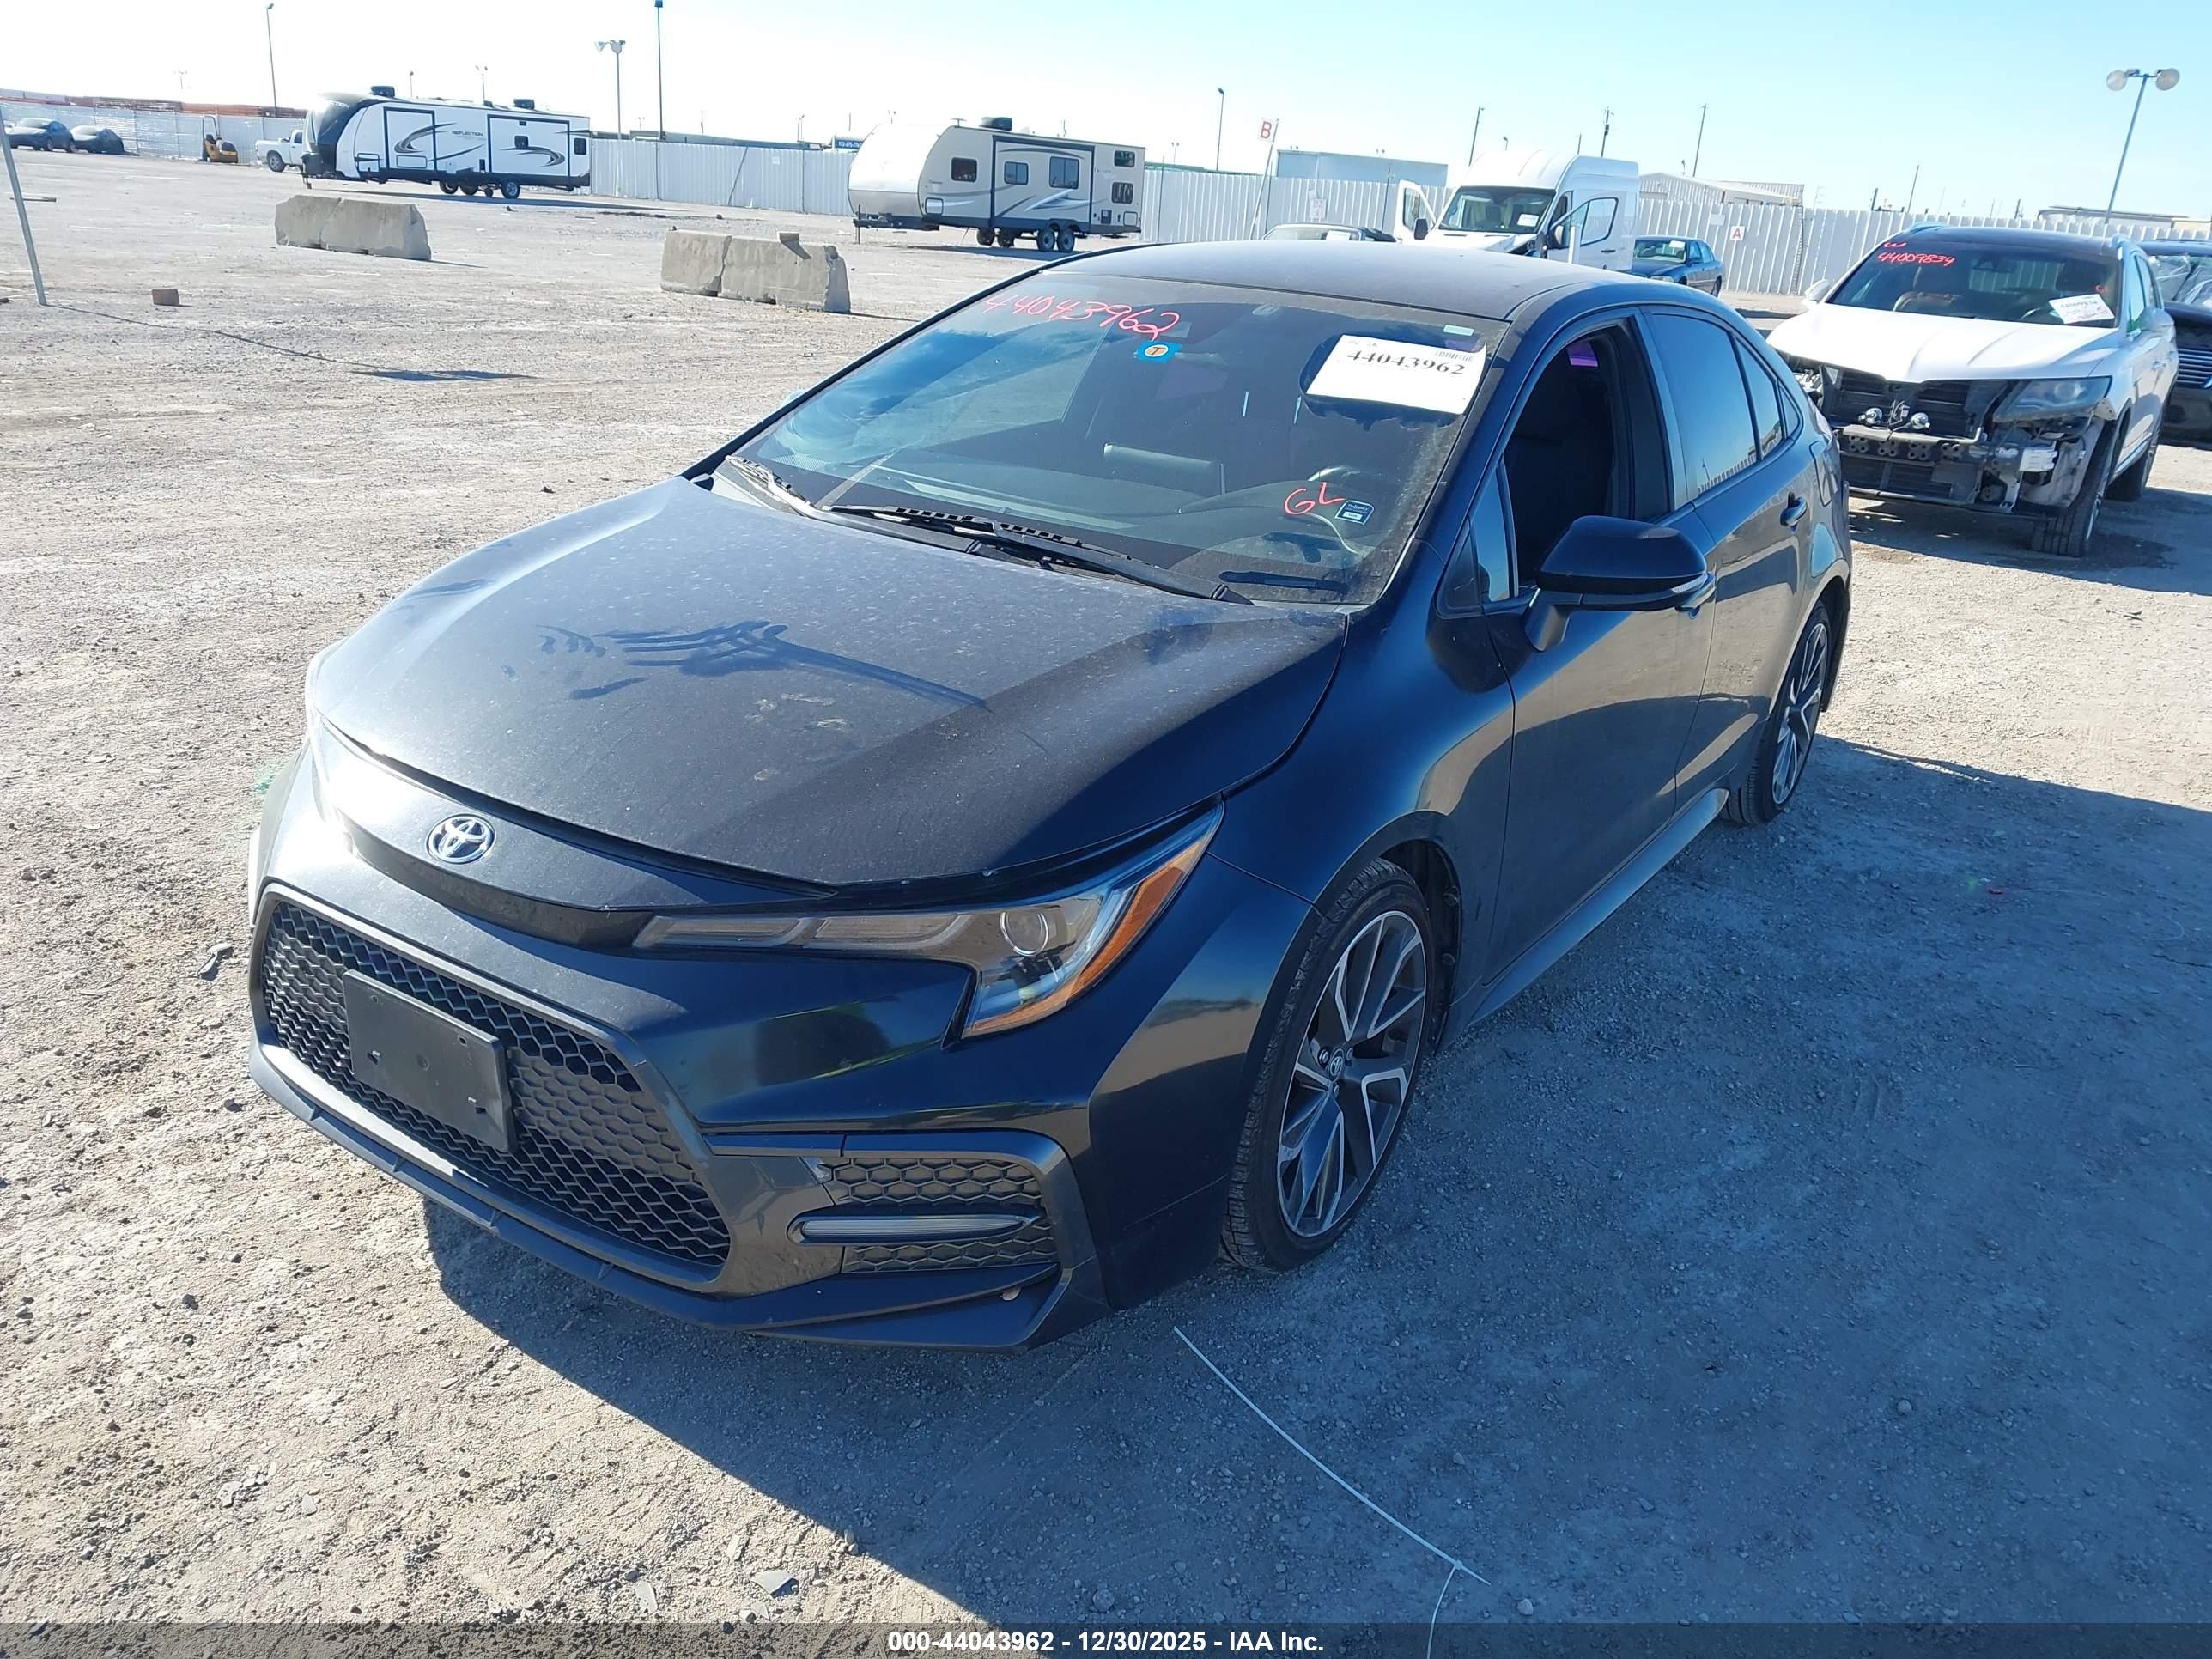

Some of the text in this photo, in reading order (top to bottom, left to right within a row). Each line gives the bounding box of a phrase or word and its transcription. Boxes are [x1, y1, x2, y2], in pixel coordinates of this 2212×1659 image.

[1260, 121, 1273, 139] B
[1732, 228, 1741, 239] A
[1877, 252, 1956, 267] 44009834
[981, 295, 1180, 342] 44043962
[1346, 349, 1467, 375] 44043962
